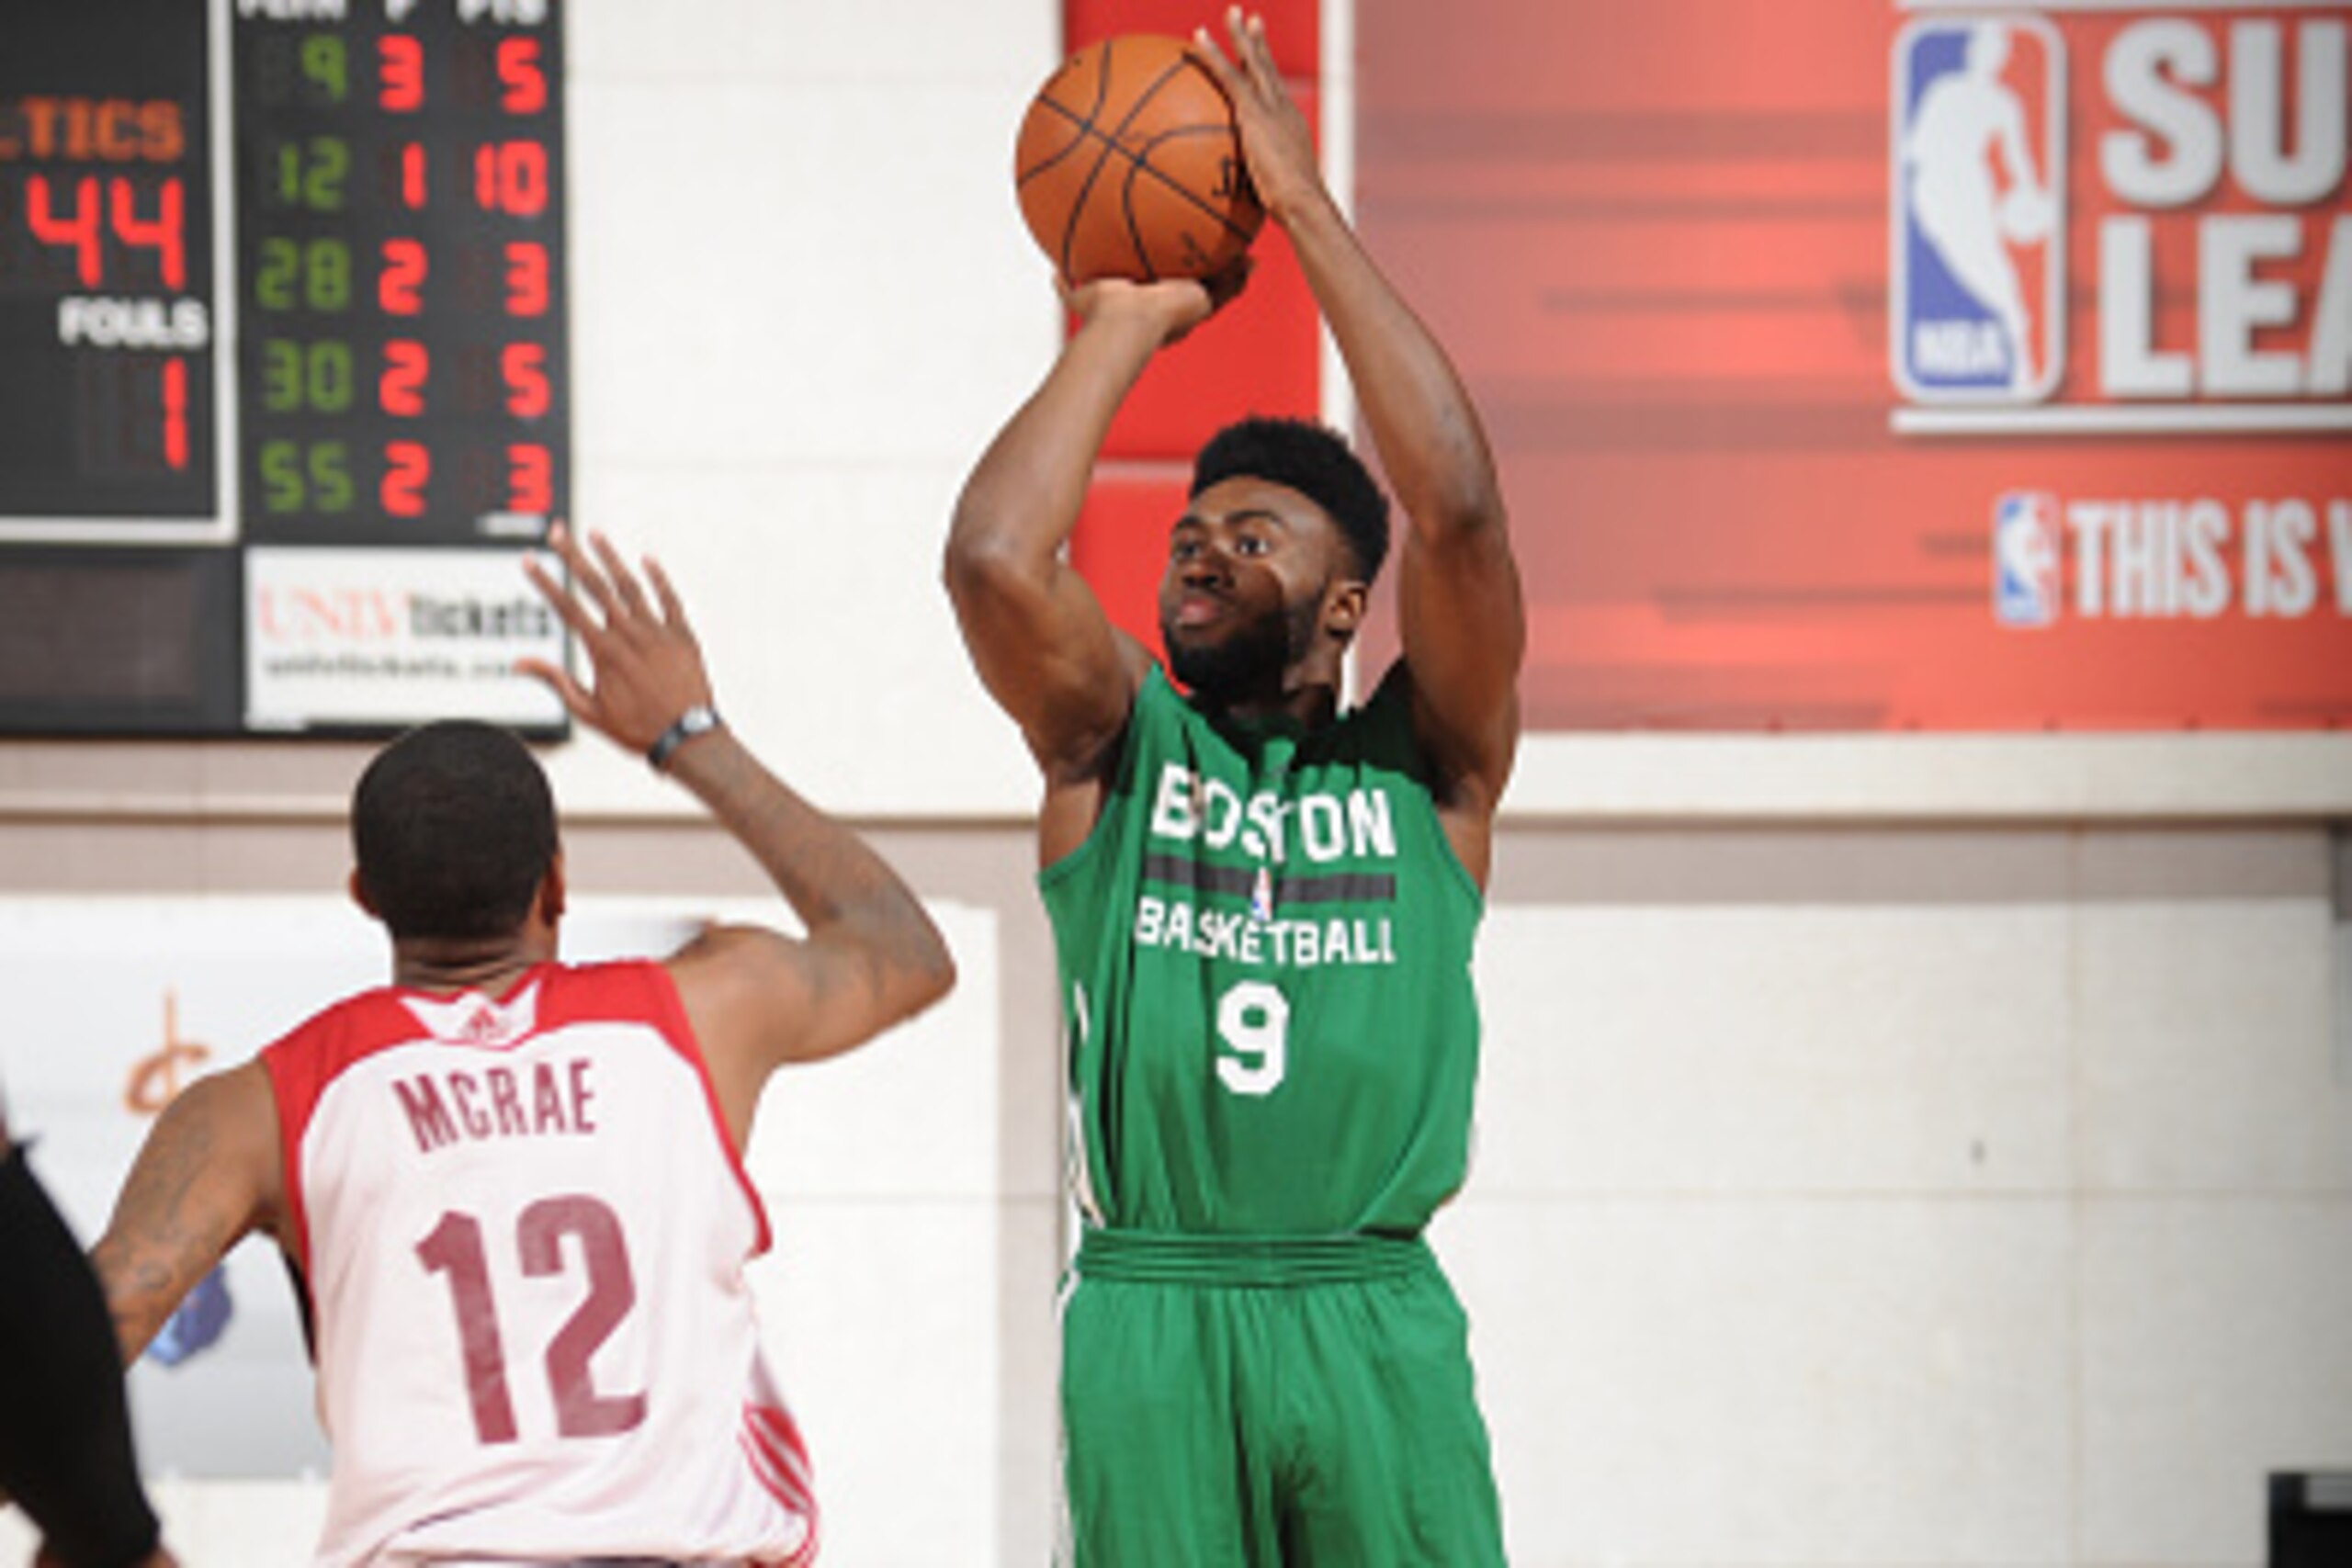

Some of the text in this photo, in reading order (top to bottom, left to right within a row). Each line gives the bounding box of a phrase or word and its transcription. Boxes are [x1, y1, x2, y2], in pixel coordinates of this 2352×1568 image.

[301, 35, 547, 113] 9 3 5
[281, 140, 548, 216] 12 1 10
[25, 175, 186, 291] 44
[255, 239, 548, 316] 28 2 3
[58, 297, 209, 347] FOULS
[162, 356, 187, 470] 1
[263, 339, 550, 417] 30 2 5
[259, 442, 552, 516] 55 2 3
[2066, 497, 2233, 619] THIS
[2243, 497, 2318, 619] IS
[1149, 760, 1396, 865] BOSTON
[1133, 895, 1396, 966] BASKETBALL
[1215, 979, 1290, 1096] 9
[391, 1058, 598, 1154] MCRAE
[414, 1193, 649, 1445] 12
